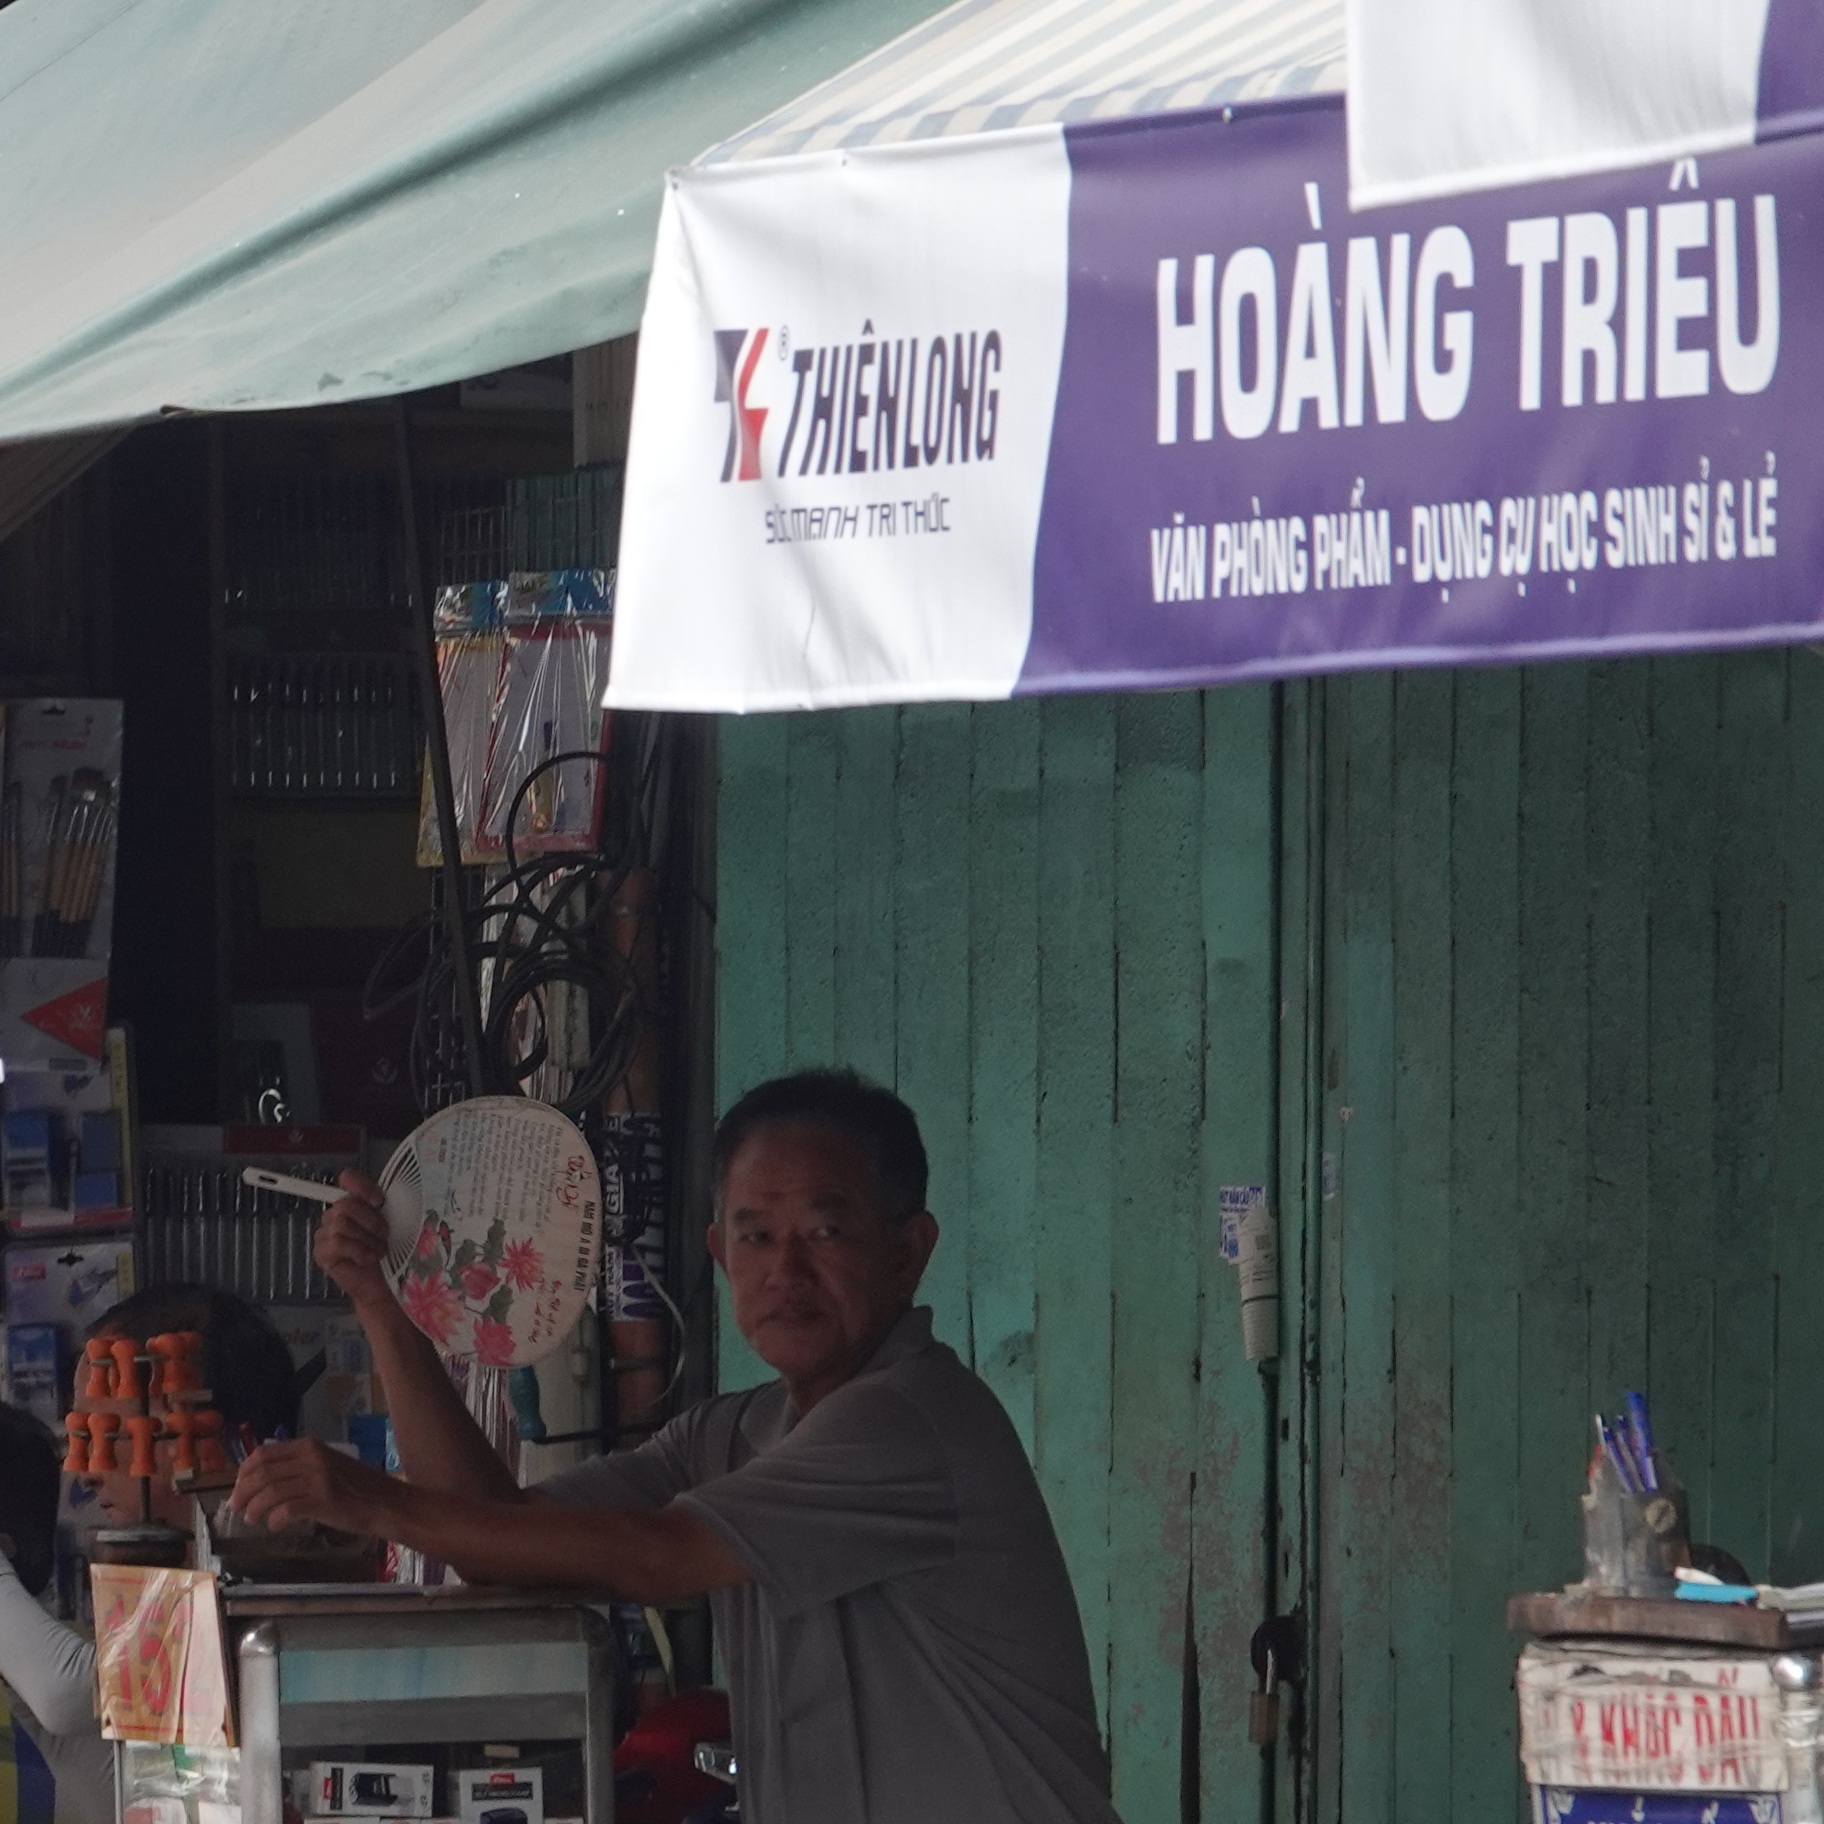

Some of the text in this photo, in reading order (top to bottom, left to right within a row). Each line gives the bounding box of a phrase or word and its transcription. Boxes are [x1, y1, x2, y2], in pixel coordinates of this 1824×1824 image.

[1157, 183, 1475, 445] HOÀNG
[777, 318, 1002, 478] THIÊNLONG
[867, 502, 897, 537] TRI
[1151, 450, 1778, 603] VĂN PHÒNG PHẨM - DỤNG CỤ HỌC SINH SỈ & LẺ
